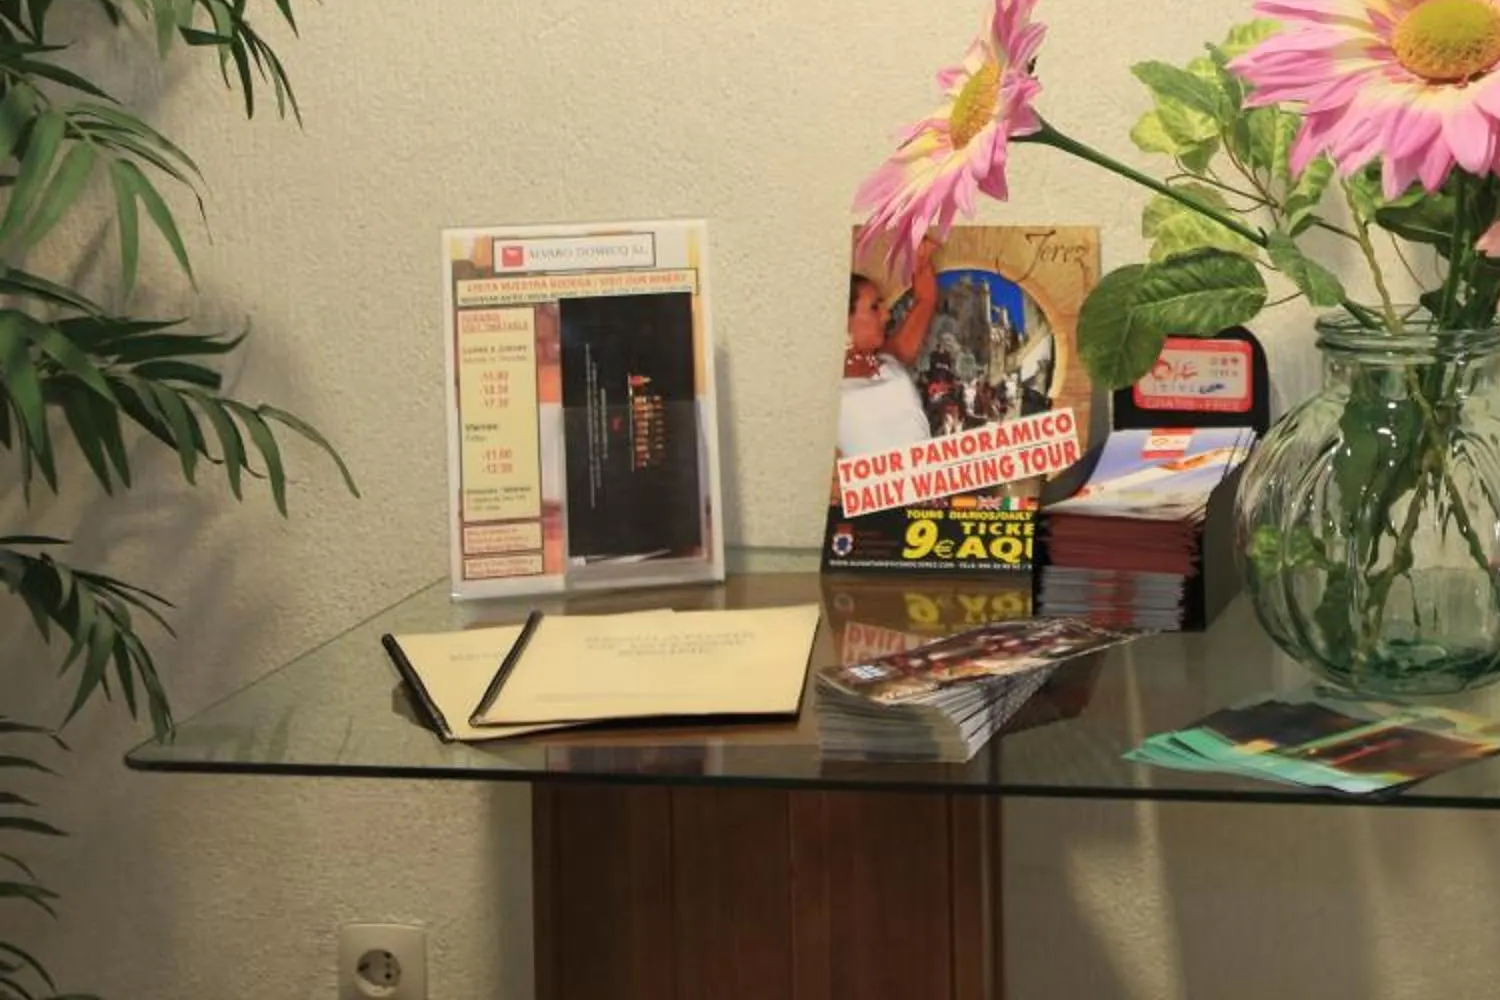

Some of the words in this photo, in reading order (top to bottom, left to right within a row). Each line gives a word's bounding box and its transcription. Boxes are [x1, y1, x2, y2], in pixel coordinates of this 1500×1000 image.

[840, 451, 904, 483] TOUR
[911, 413, 1073, 467] PANORAMICO
[844, 478, 905, 516] DAILY
[912, 455, 1015, 498] WALKING
[1020, 439, 1079, 473] TOUR
